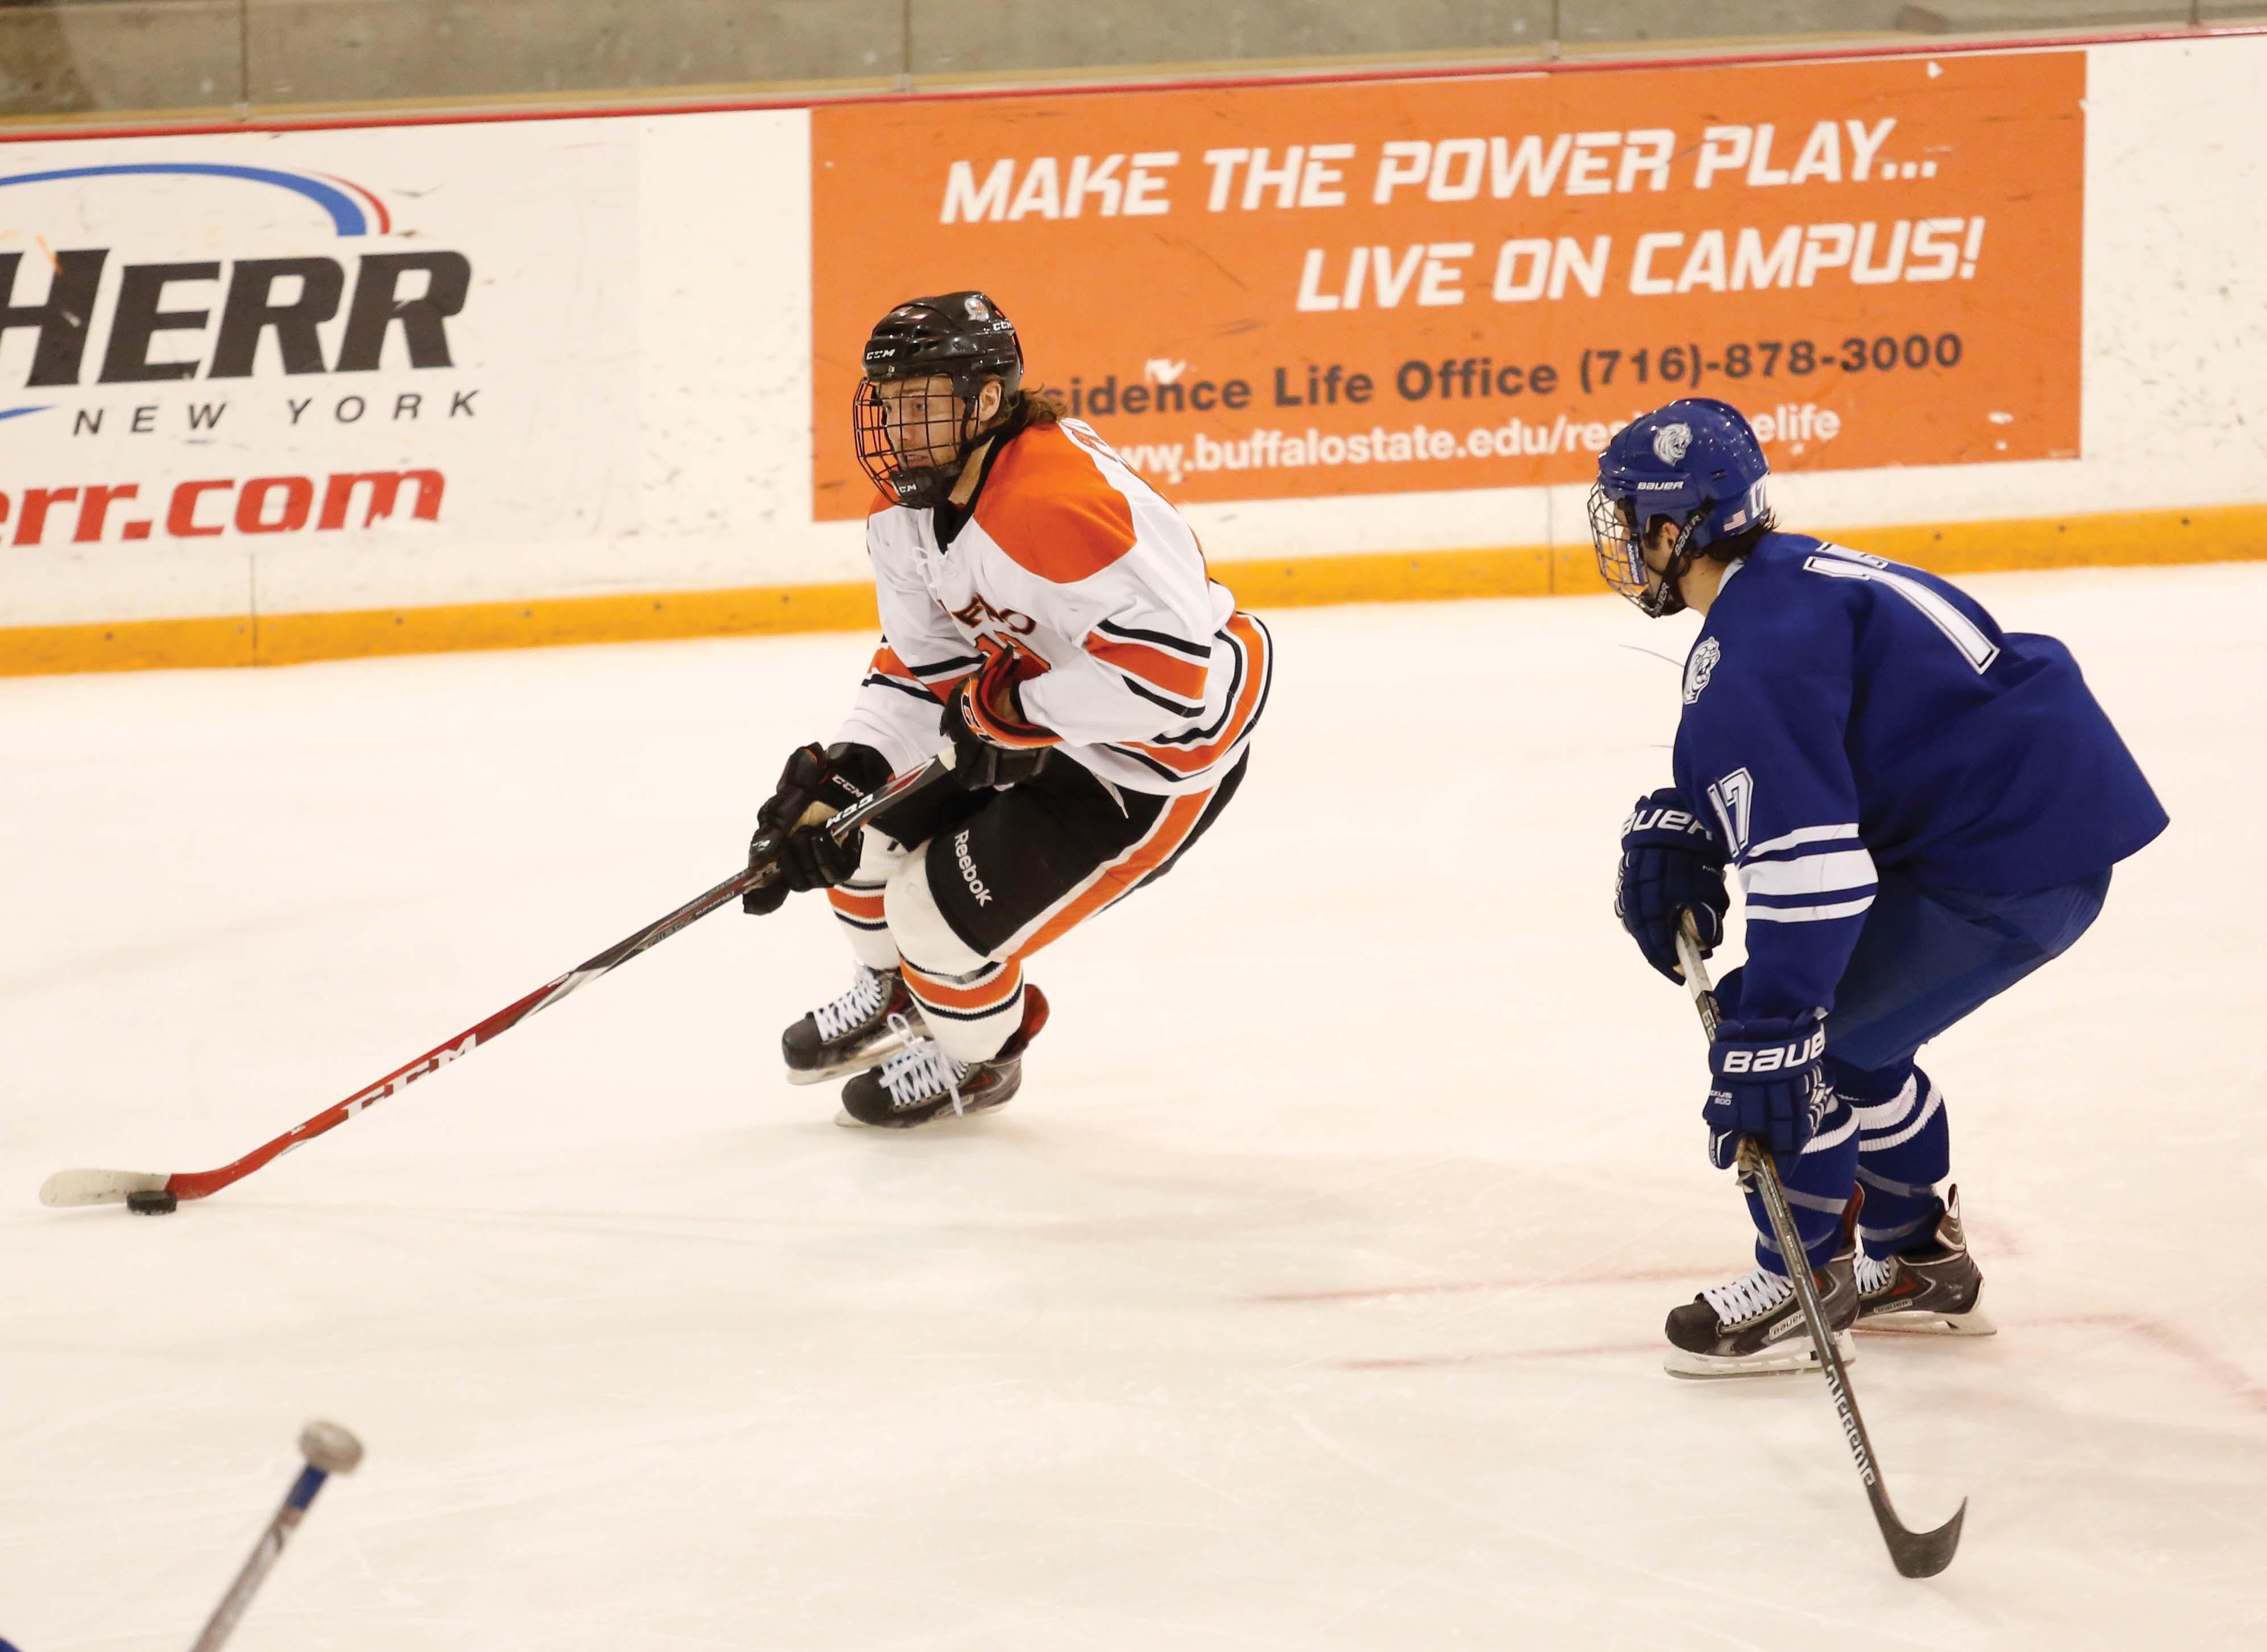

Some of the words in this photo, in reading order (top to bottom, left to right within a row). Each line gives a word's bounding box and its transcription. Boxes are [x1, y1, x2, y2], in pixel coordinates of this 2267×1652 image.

[941, 151, 1179, 224] MAKE
[1204, 144, 1355, 212] THE
[1374, 129, 1675, 205] POWER
[1695, 119, 1938, 190] PLAY...
[1296, 243, 1474, 312] LIVE
[1493, 236, 1611, 303] ON
[1629, 217, 1985, 296] CAMPUS!
[0, 249, 472, 387] HERR
[866, 349, 896, 360] CCM
[1275, 365, 1372, 407] Life
[1397, 357, 1557, 400] Office
[1580, 333, 1963, 393] (716)-878-3000
[73, 401, 228, 436] NEW
[287, 390, 480, 424] YORK
[0, 469, 446, 547] rr.com
[897, 483, 917, 494] CM
[1707, 767, 1754, 858] 17
[955, 829, 993, 907] Reebok
[341, 1032, 476, 1120] CCM
